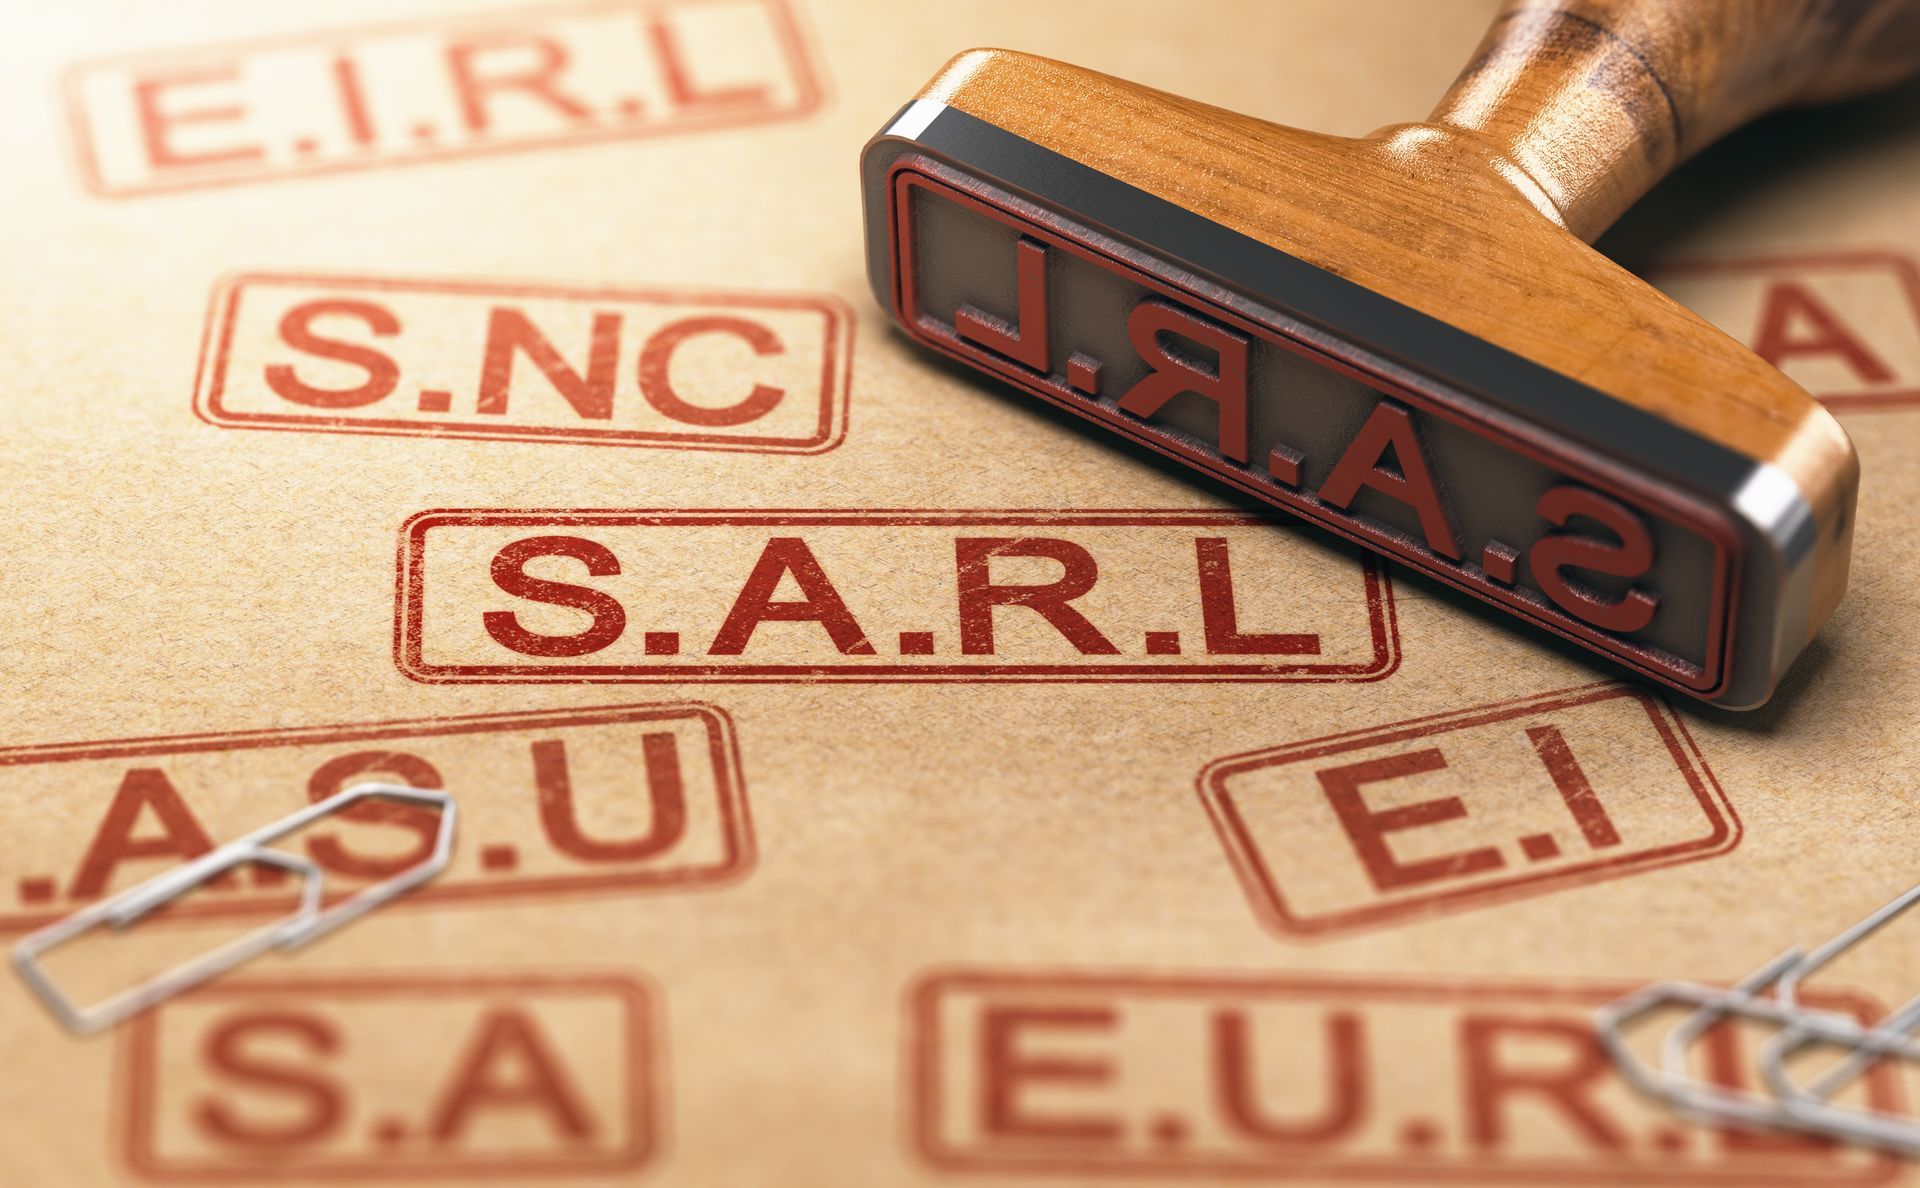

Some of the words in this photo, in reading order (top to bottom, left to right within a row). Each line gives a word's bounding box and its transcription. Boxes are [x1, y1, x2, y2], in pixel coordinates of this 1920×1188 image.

[132, 8, 775, 168] E.I.R.L
[264, 299, 787, 427] S.NC
[482, 535, 1322, 657] S.A.R.L
[1314, 725, 1621, 893] E.I
[190, 1005, 600, 1150] S.A
[978, 1005, 1846, 1156] E.U.R.L
